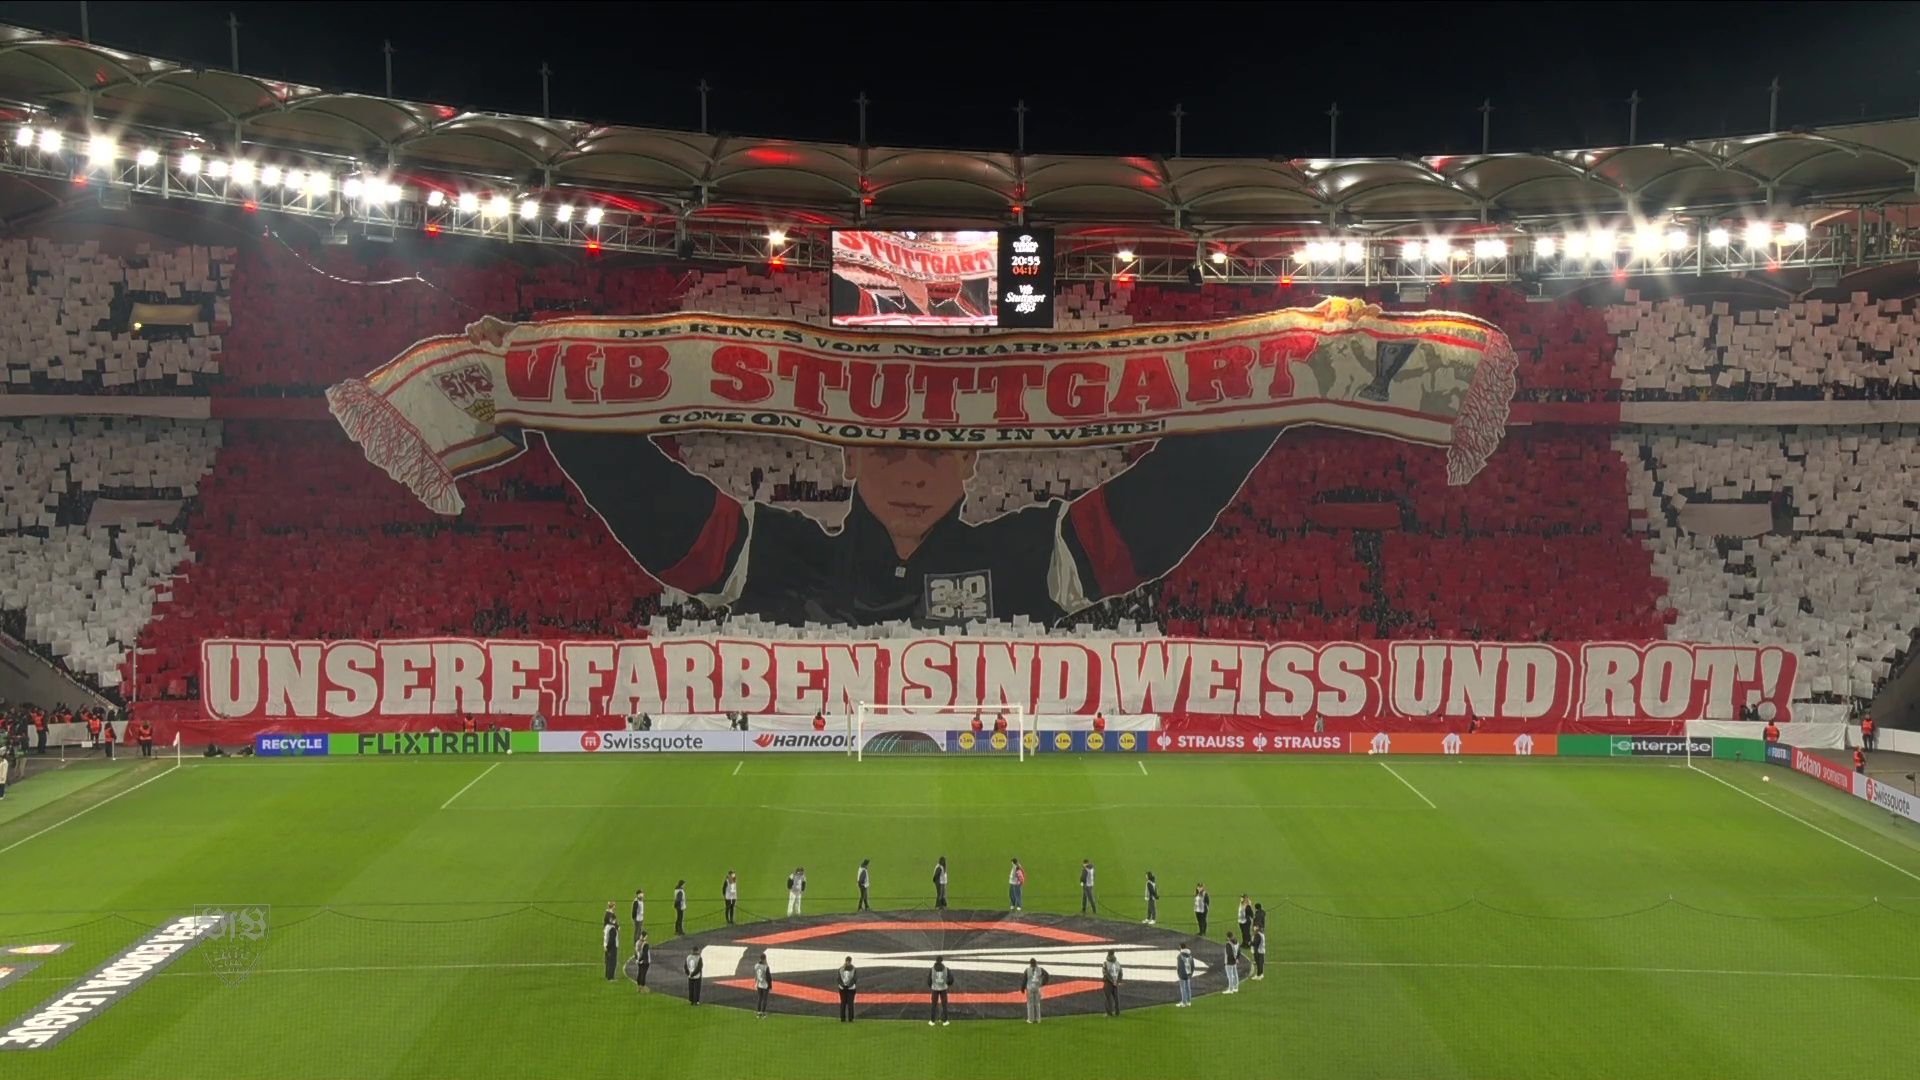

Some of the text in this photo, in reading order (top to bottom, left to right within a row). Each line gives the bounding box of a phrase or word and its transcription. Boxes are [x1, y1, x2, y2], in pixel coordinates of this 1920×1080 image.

[618, 326, 681, 338] DIE
[814, 337, 880, 354] VOM
[893, 331, 1210, 356] NECKARSTADION!
[505, 334, 1319, 423] VfB STUTTGART
[659, 410, 1166, 442] COME ON YOU BOYS IN WHITE!
[204, 640, 1785, 720] UNSERE FARBEN SIND WEISS UND ROT!
[262, 738, 322, 750] RECYCLE
[603, 733, 703, 752] Swissquote
[1178, 735, 1245, 748] STRAUSS
[1274, 736, 1341, 749] STRAUSS
[1615, 740, 1711, 754] enterprise
[1796, 750, 1821, 778] Betano
[1873, 783, 1911, 815] Swissquote
[77, 943, 185, 990] EUROPA
[0, 989, 117, 1048] LEAGUE
